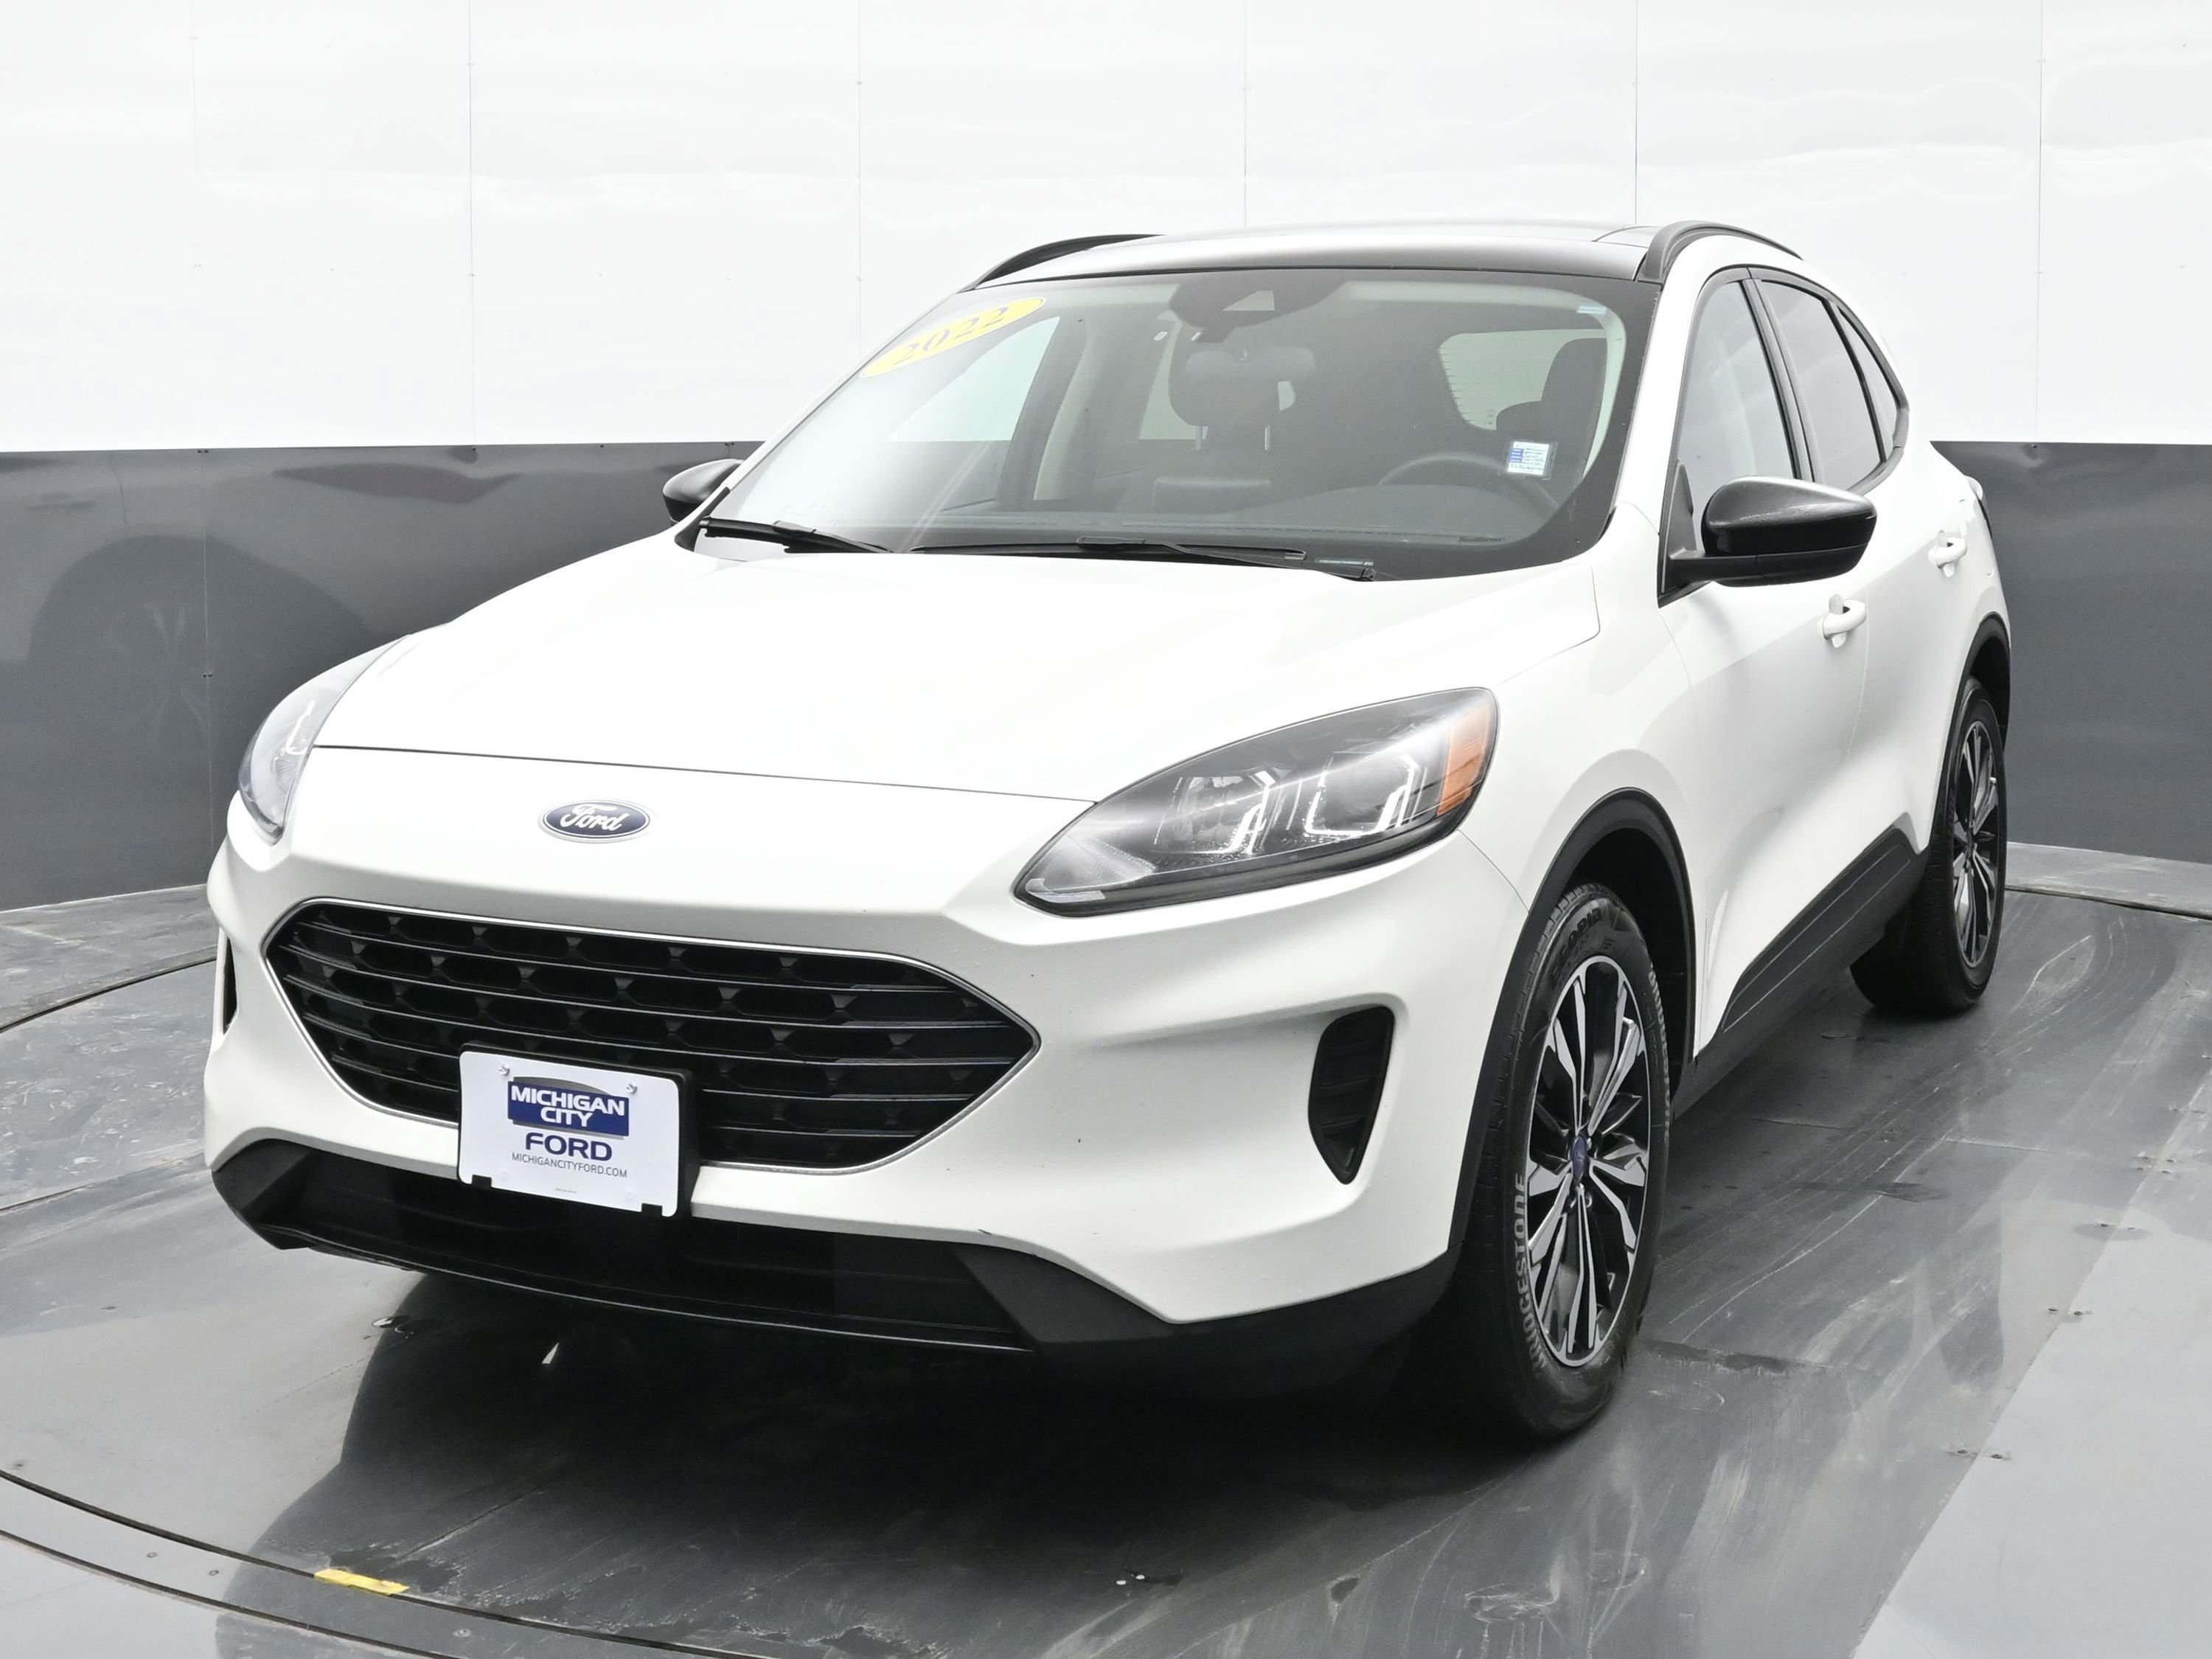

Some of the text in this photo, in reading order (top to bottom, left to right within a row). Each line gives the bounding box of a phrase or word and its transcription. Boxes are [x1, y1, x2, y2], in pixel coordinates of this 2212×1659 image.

[891, 306, 1009, 366] 2022
[560, 803, 630, 831] Ford
[510, 1085, 625, 1116] MICHIGAN
[540, 1107, 593, 1127] CITY
[525, 1132, 613, 1161] FORD
[511, 1152, 627, 1178] MICHIGANCITYFORD.COM
